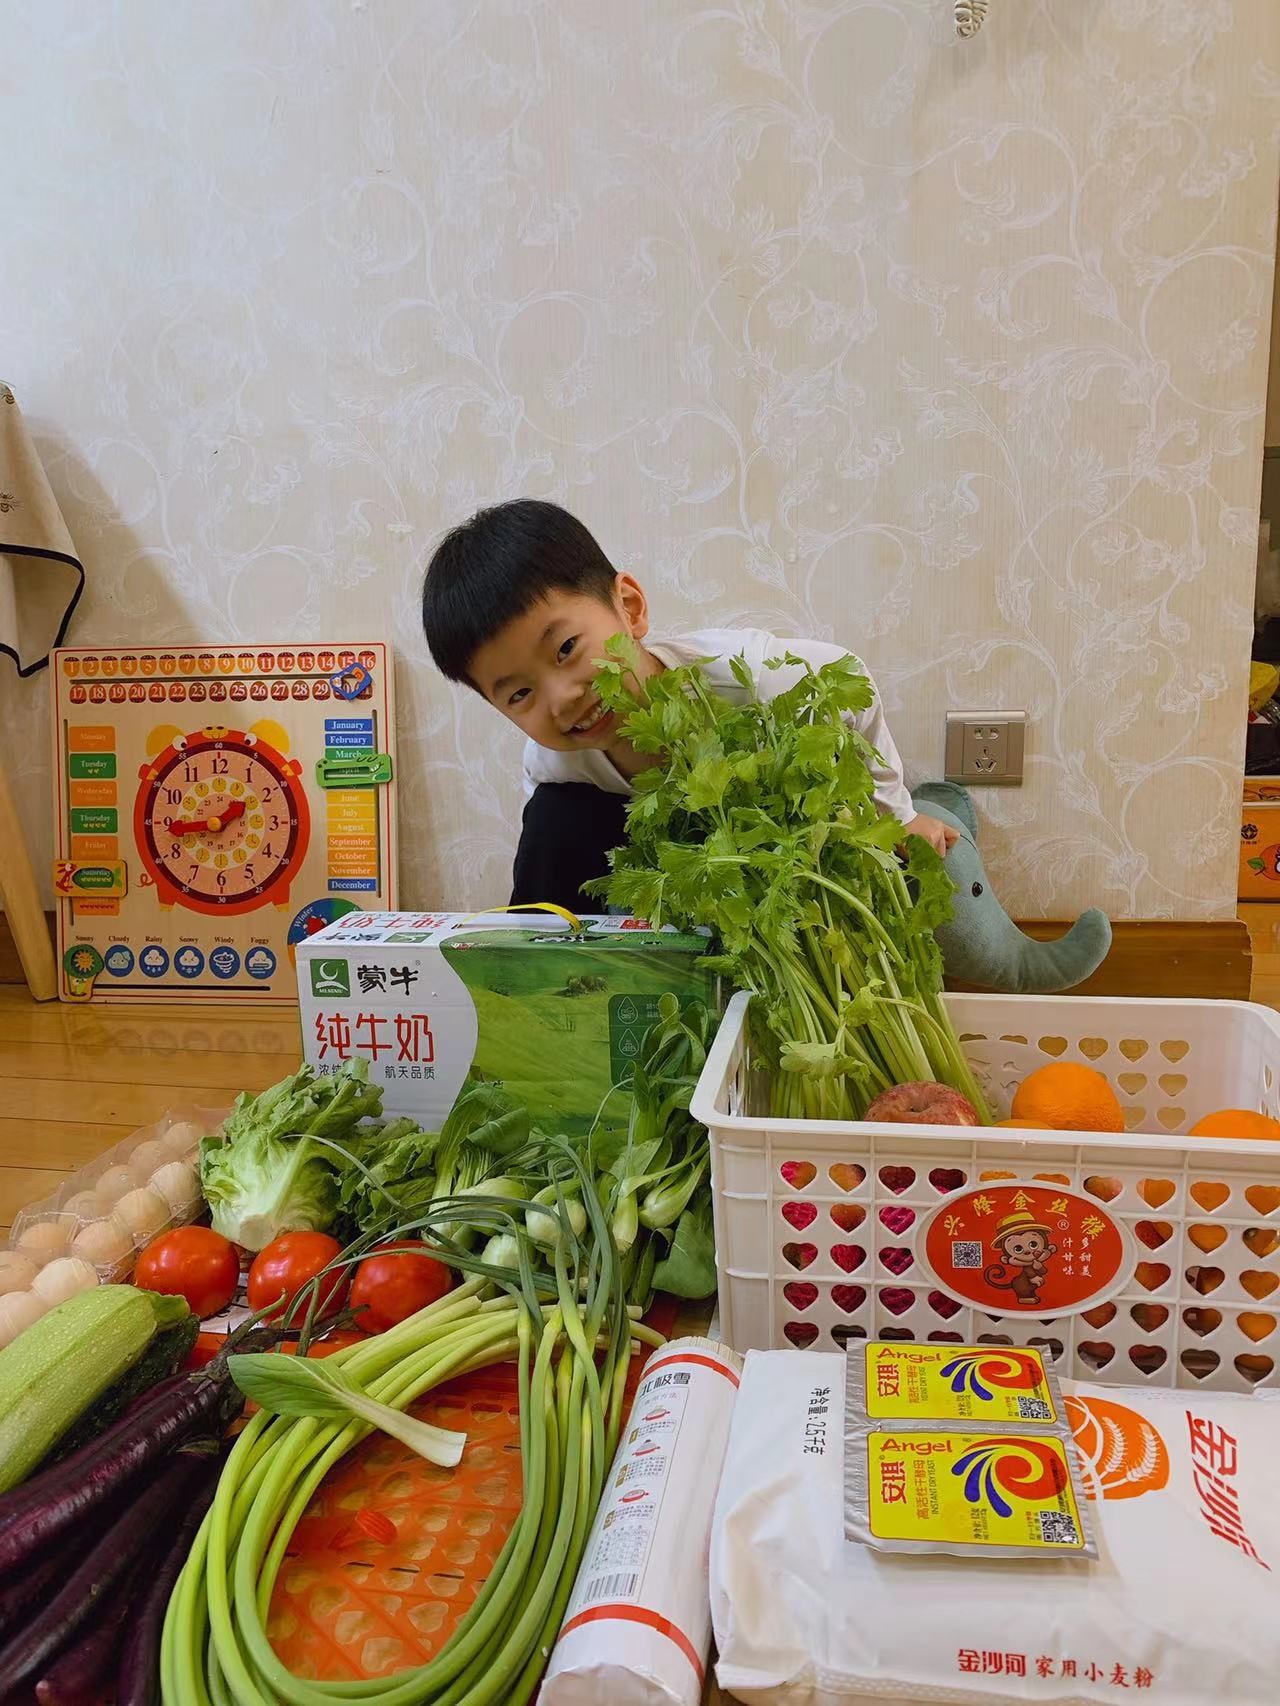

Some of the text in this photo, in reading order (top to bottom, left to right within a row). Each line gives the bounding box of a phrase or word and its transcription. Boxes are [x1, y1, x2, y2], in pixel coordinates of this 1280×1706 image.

[87, 661, 95, 673] 2
[107, 661, 114, 673] 3
[125, 660, 133, 672] 4
[144, 660, 152, 671] 5
[164, 660, 172, 672] 6
[184, 660, 191, 671] 7
[203, 659, 211, 670] 8
[223, 658, 230, 670] 9
[241, 658, 253, 669] 10
[260, 658, 273, 670] 11
[281, 658, 293, 669] 12
[301, 657, 314, 669] 13
[321, 657, 334, 668] 14
[341, 656, 354, 668] 15
[362, 656, 374, 668] 16
[72, 688, 84, 699] 17
[92, 688, 104, 699] 18
[113, 687, 125, 698] 19
[131, 687, 145, 698] 20
[151, 687, 163, 697] 21
[170, 686, 184, 697] 22
[191, 686, 204, 697] 23
[211, 685, 225, 696] 24
[232, 685, 245, 696] 25
[252, 685, 266, 696] 26
[273, 684, 286, 696] 27
[294, 684, 307, 695] 28
[314, 684, 329, 695] 29
[331, 720, 365, 731] January
[329, 735, 367, 745] February
[178, 752, 187, 760] 55
[335, 750, 362, 759] March
[80, 760, 108, 768] Tuesday
[211, 758, 228, 774] 12
[184, 767, 199, 783] 11
[245, 767, 253, 783] 1
[166, 789, 182, 804] 10
[262, 787, 271, 803] 2
[80, 814, 111, 822] Thursday
[342, 808, 358, 817] July
[269, 815, 279, 831] 3
[290, 818, 298, 826] 15
[336, 823, 365, 832] August
[85, 841, 106, 849] Friday
[262, 842, 272, 858] 4
[329, 837, 371, 847] September
[171, 843, 181, 859] 8
[334, 852, 367, 860] October
[189, 864, 199, 880] 7
[216, 870, 226, 886] 6
[244, 863, 254, 879] 5
[331, 866, 371, 875] November
[331, 880, 371, 889] December
[293, 906, 313, 928] Winter
[75, 935, 94, 943] Sunny
[145, 936, 163, 944] Rainy
[179, 936, 199, 944] Snowy
[214, 936, 235, 944] Windy
[250, 936, 270, 945] Foggy
[357, 964, 419, 996] 蒙牛
[315, 1012, 435, 1062] 纯牛奶
[385, 1065, 435, 1080] 航天品质
[876, 1347, 941, 1364] Angel
[641, 1372, 691, 1397] 北极雪
[877, 1363, 900, 1397] 安琪
[880, 1438, 953, 1456] Angel
[881, 1460, 907, 1504] 安琪
[913, 1459, 930, 1520] 高活性干酵母
[927, 1459, 940, 1515] INSTANT DRY YEAST
[957, 1648, 1155, 1688] 金沙河 家用小麦粉
